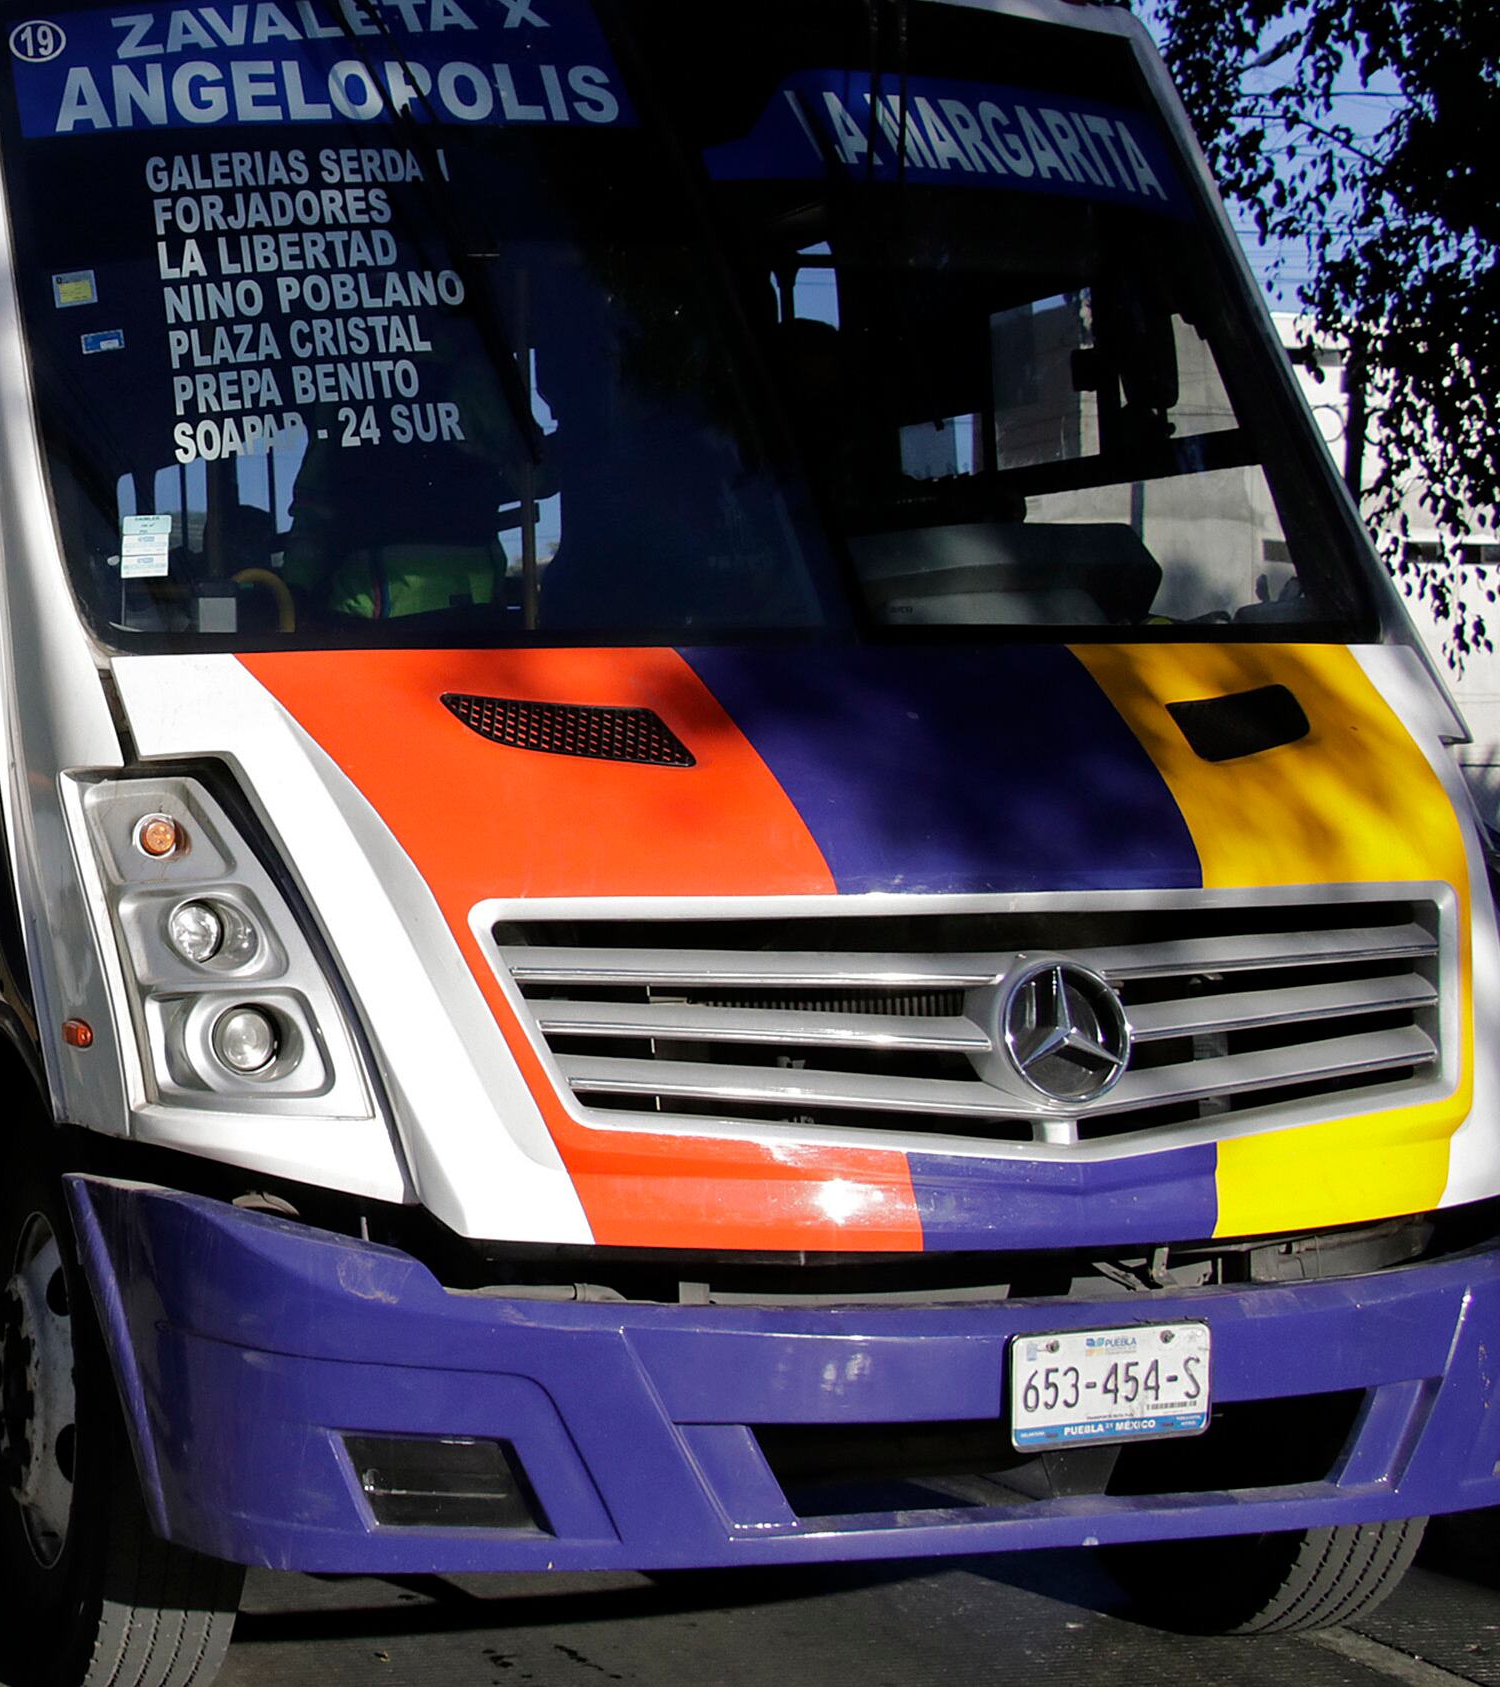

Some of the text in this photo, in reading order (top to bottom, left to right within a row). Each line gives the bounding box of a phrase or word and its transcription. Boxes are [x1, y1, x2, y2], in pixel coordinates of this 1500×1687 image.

[20, 25, 55, 57] 19
[111, 0, 551, 59] ZAVALETA X
[55, 60, 619, 132] ANGELOPOLIS
[145, 149, 310, 193] GALERIAS
[863, 92, 1169, 201] MARGARITA
[153, 188, 392, 235] FORJADORES
[157, 229, 398, 279] LA LIBERTAD
[163, 269, 465, 324] NINO POBLANO
[168, 322, 282, 369] PLAZA
[289, 314, 433, 358] CRISTAL
[172, 359, 420, 416] PREPA BENITO
[337, 405, 382, 448] 24
[390, 402, 466, 444] SUR
[1023, 1355, 1202, 1413] 653-454-S
[1063, 1423, 1105, 1436] PUEBLA
